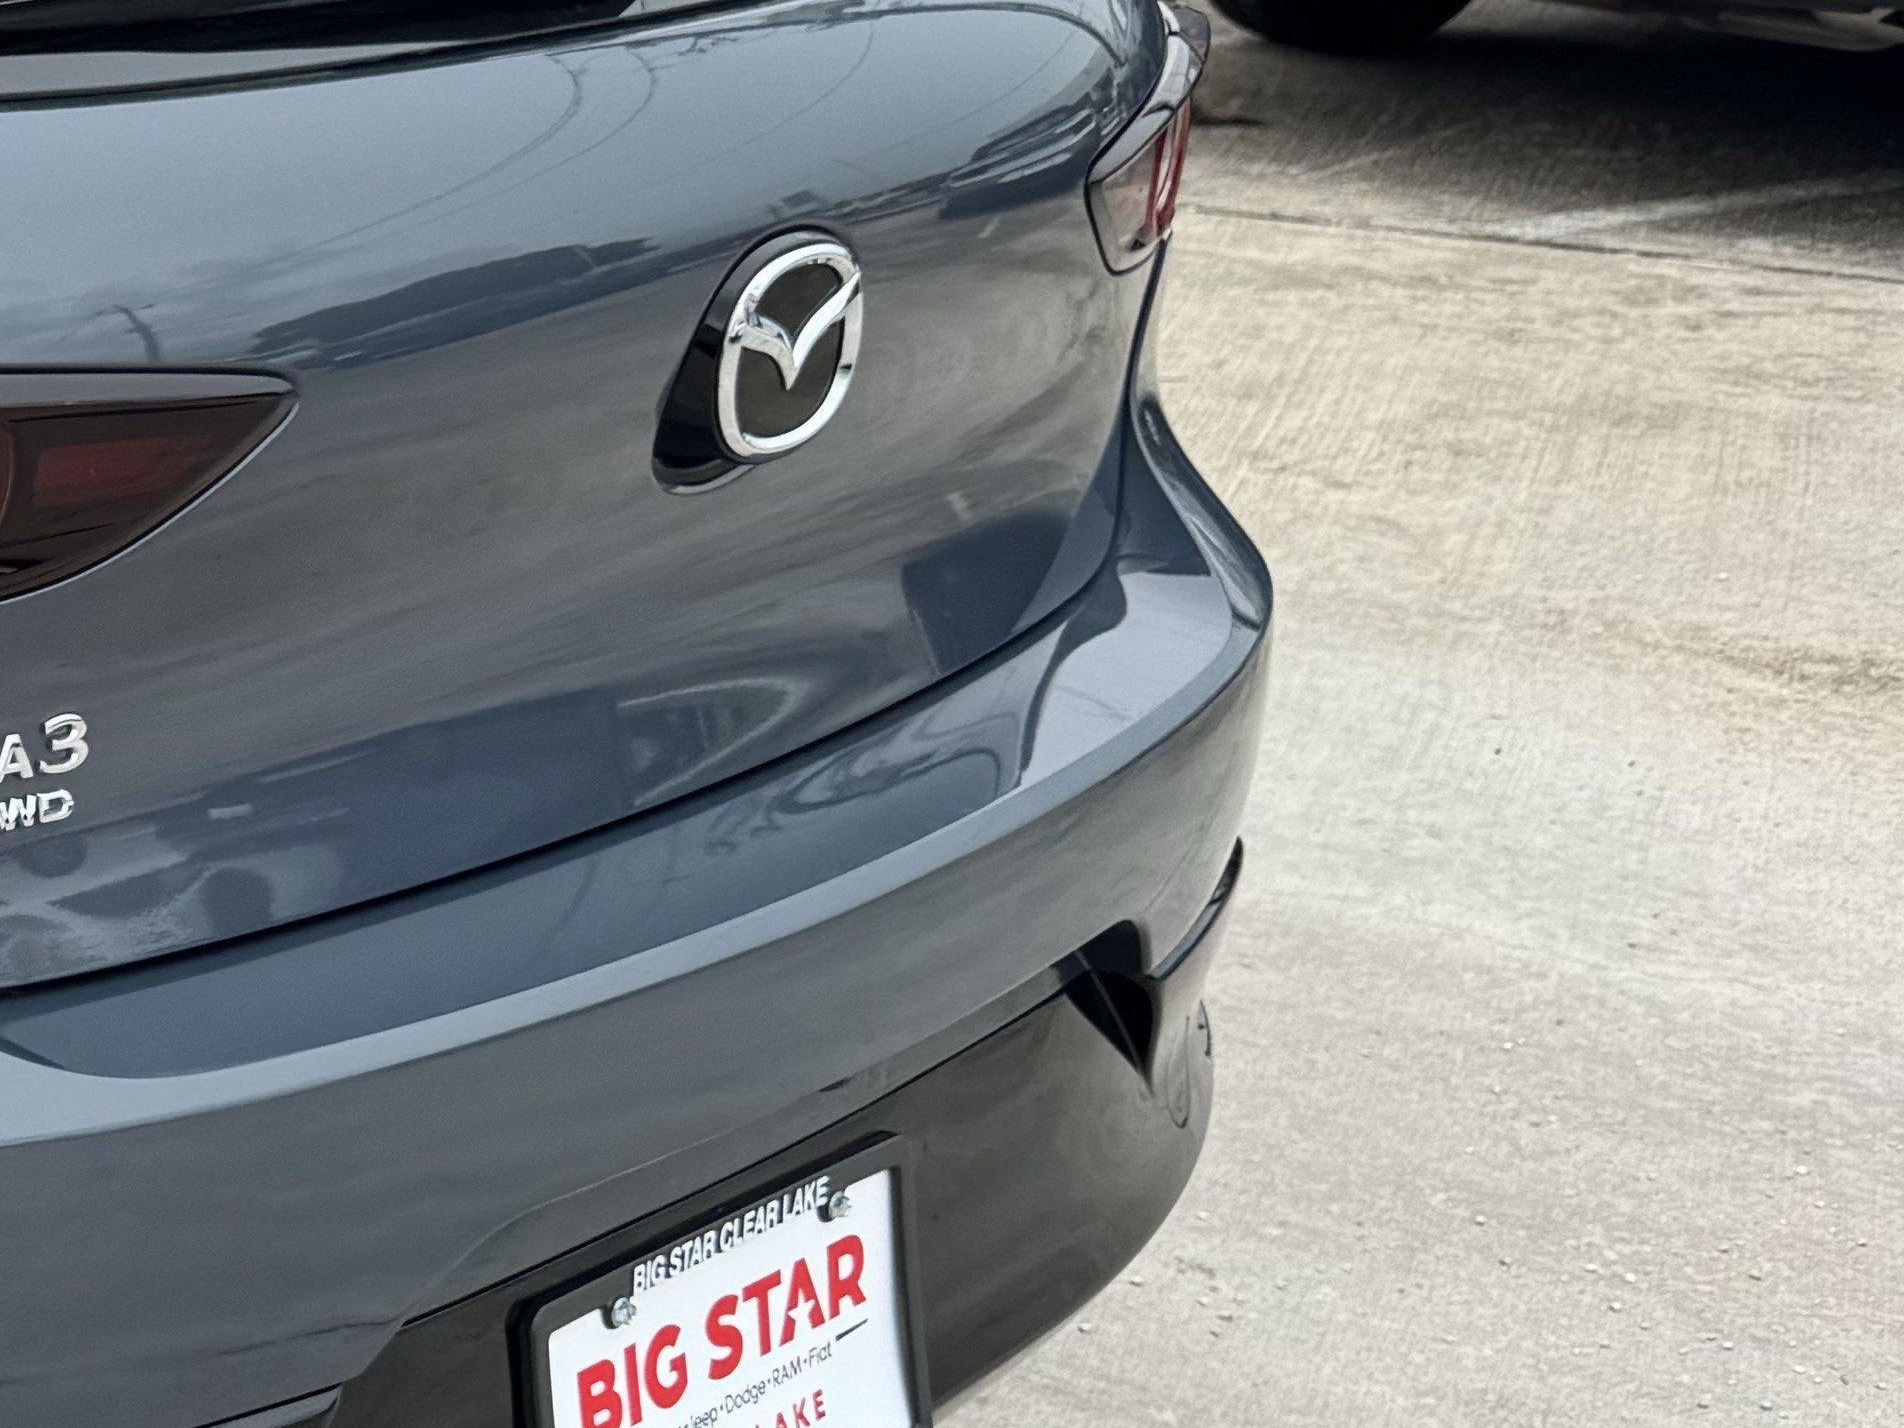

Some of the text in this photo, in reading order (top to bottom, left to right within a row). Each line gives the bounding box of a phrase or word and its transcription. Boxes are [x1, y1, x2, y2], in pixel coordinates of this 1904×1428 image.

[632, 1175, 830, 1295] BIG STAR CLEAR LAKE
[703, 1234, 867, 1381] STAR
[724, 1379, 767, 1414] Dodge
[771, 1356, 802, 1388] RAM
[808, 1341, 832, 1369] Fiat
